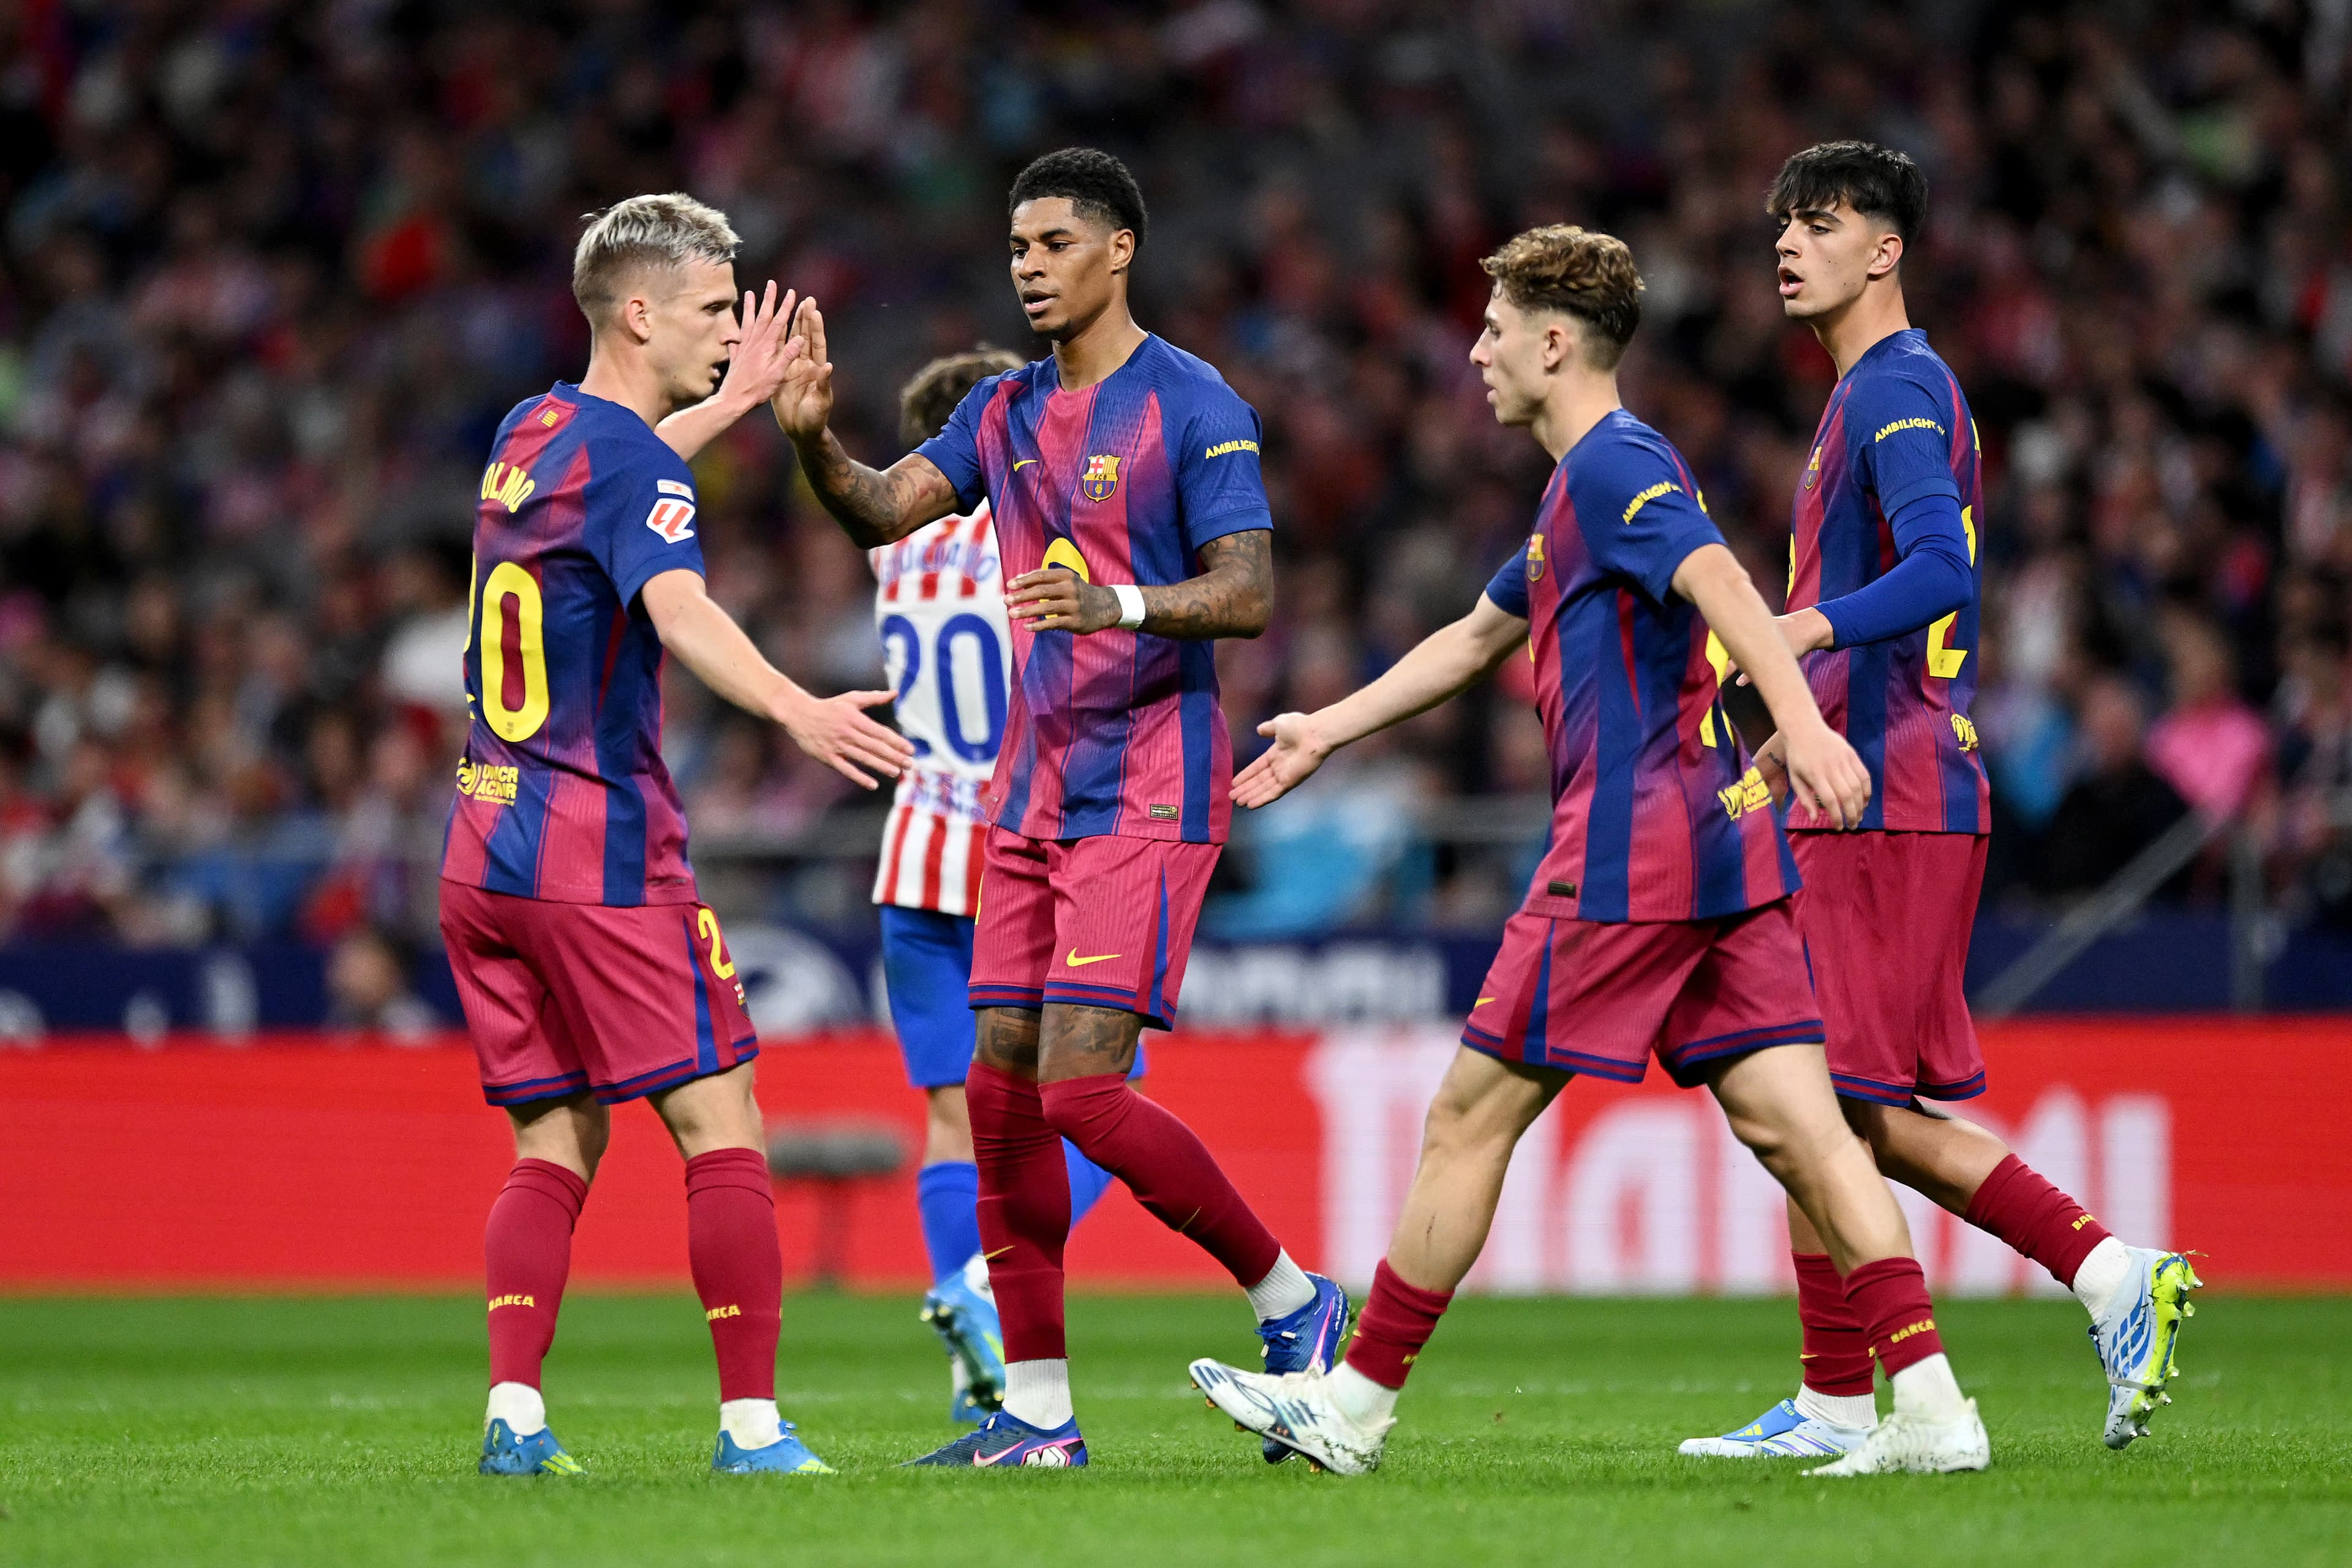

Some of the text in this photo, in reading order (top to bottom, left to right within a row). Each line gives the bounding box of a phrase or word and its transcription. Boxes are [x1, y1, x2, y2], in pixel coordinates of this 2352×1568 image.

[1205, 440, 1257, 459] AMBILIGHT
[1875, 418, 1936, 443] AMBILIGHT
[481, 461, 535, 513] OLMO
[880, 612, 1008, 764] 20
[698, 908, 736, 980] 2
